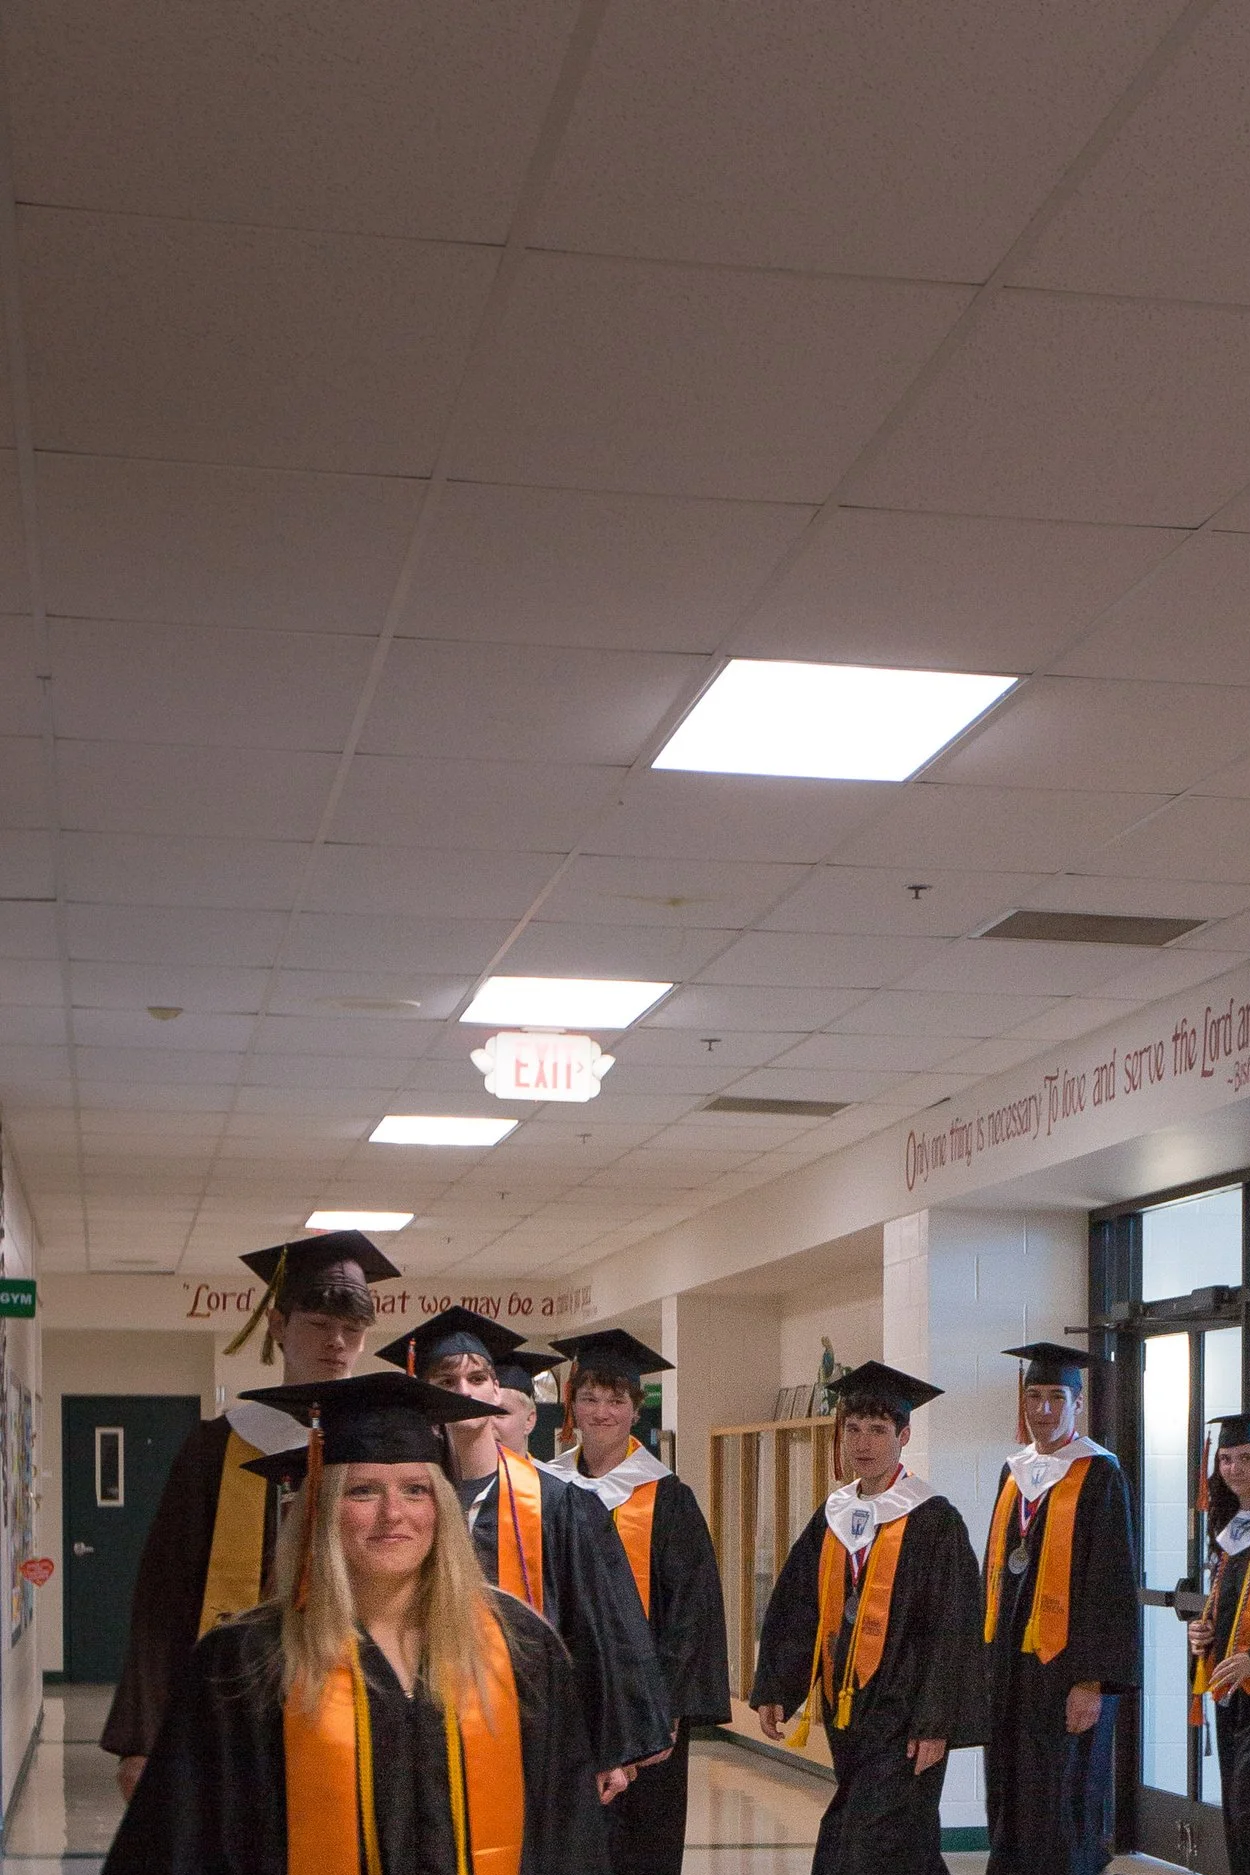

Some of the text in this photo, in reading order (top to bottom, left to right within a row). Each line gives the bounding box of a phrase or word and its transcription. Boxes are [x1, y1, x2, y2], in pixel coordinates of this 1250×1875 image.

[514, 1041, 572, 1089] EXIT
[906, 1130, 929, 1191] Only
[931, 1133, 946, 1170] one
[949, 1117, 973, 1168] thing
[976, 1110, 984, 1152] is
[988, 1091, 1042, 1148] necessary
[1044, 1068, 1059, 1136] To
[1062, 1069, 1087, 1119] love
[1093, 1048, 1117, 1107] and
[1124, 1040, 1165, 1094] serve
[1172, 1018, 1198, 1077] the
[1201, 998, 1234, 1078] Lord
[0, 1292, 33, 1306] GYM
[418, 1293, 451, 1315] we
[460, 1294, 501, 1319] may
[508, 1291, 533, 1316] be
